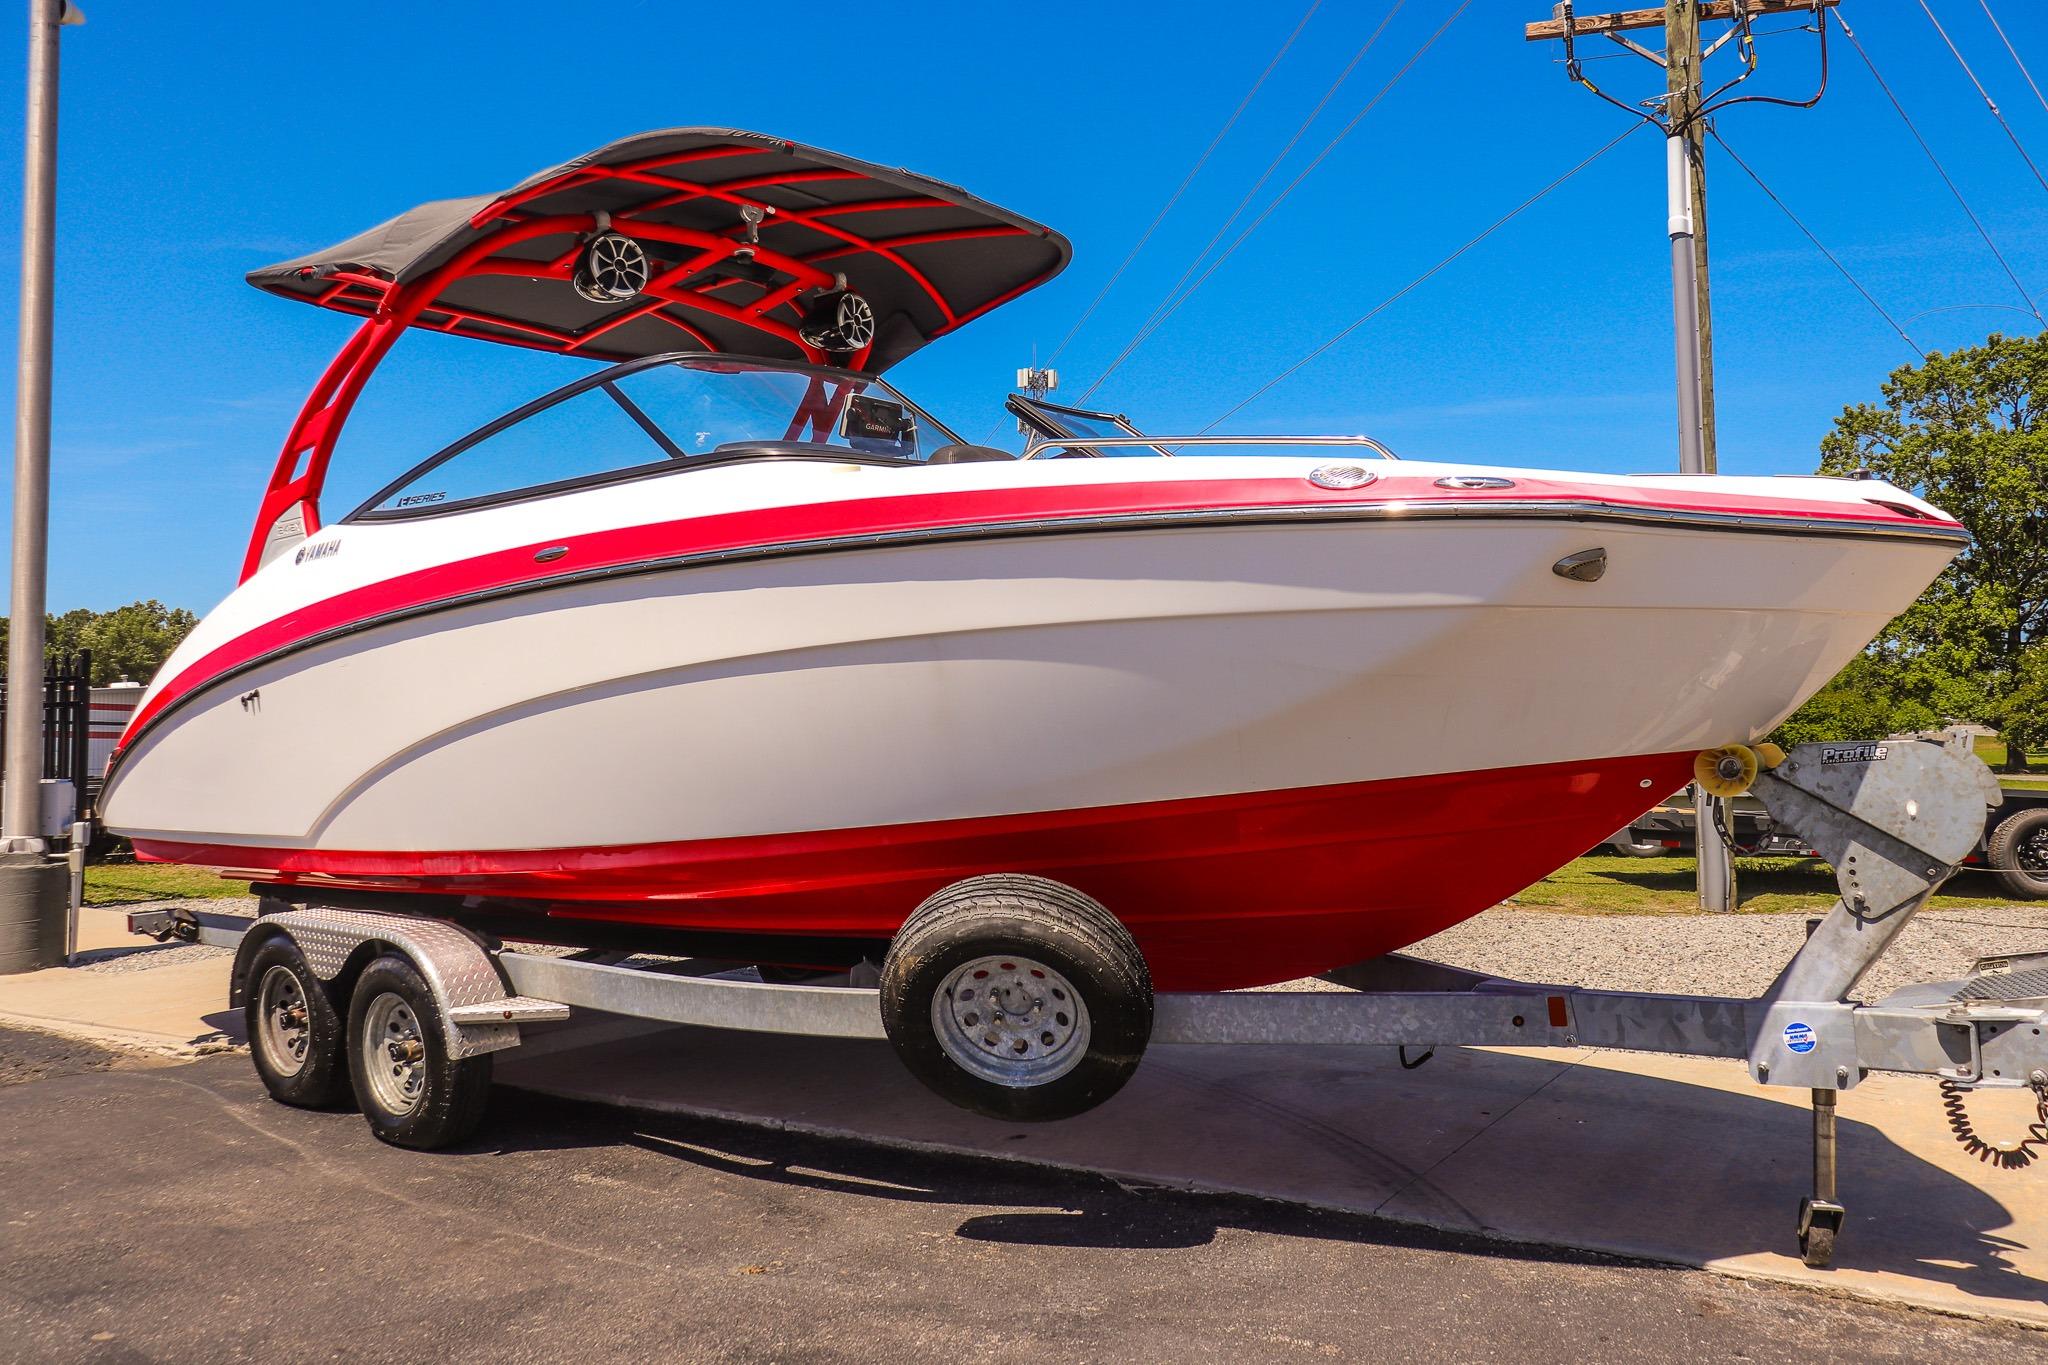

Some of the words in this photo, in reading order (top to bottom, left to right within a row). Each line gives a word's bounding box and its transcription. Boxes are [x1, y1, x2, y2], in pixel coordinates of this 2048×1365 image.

[865, 423, 891, 434] GARMIN
[409, 491, 447, 505] SERIES
[304, 539, 342, 562] YAMAHA
[1822, 745, 1888, 760] Profile
